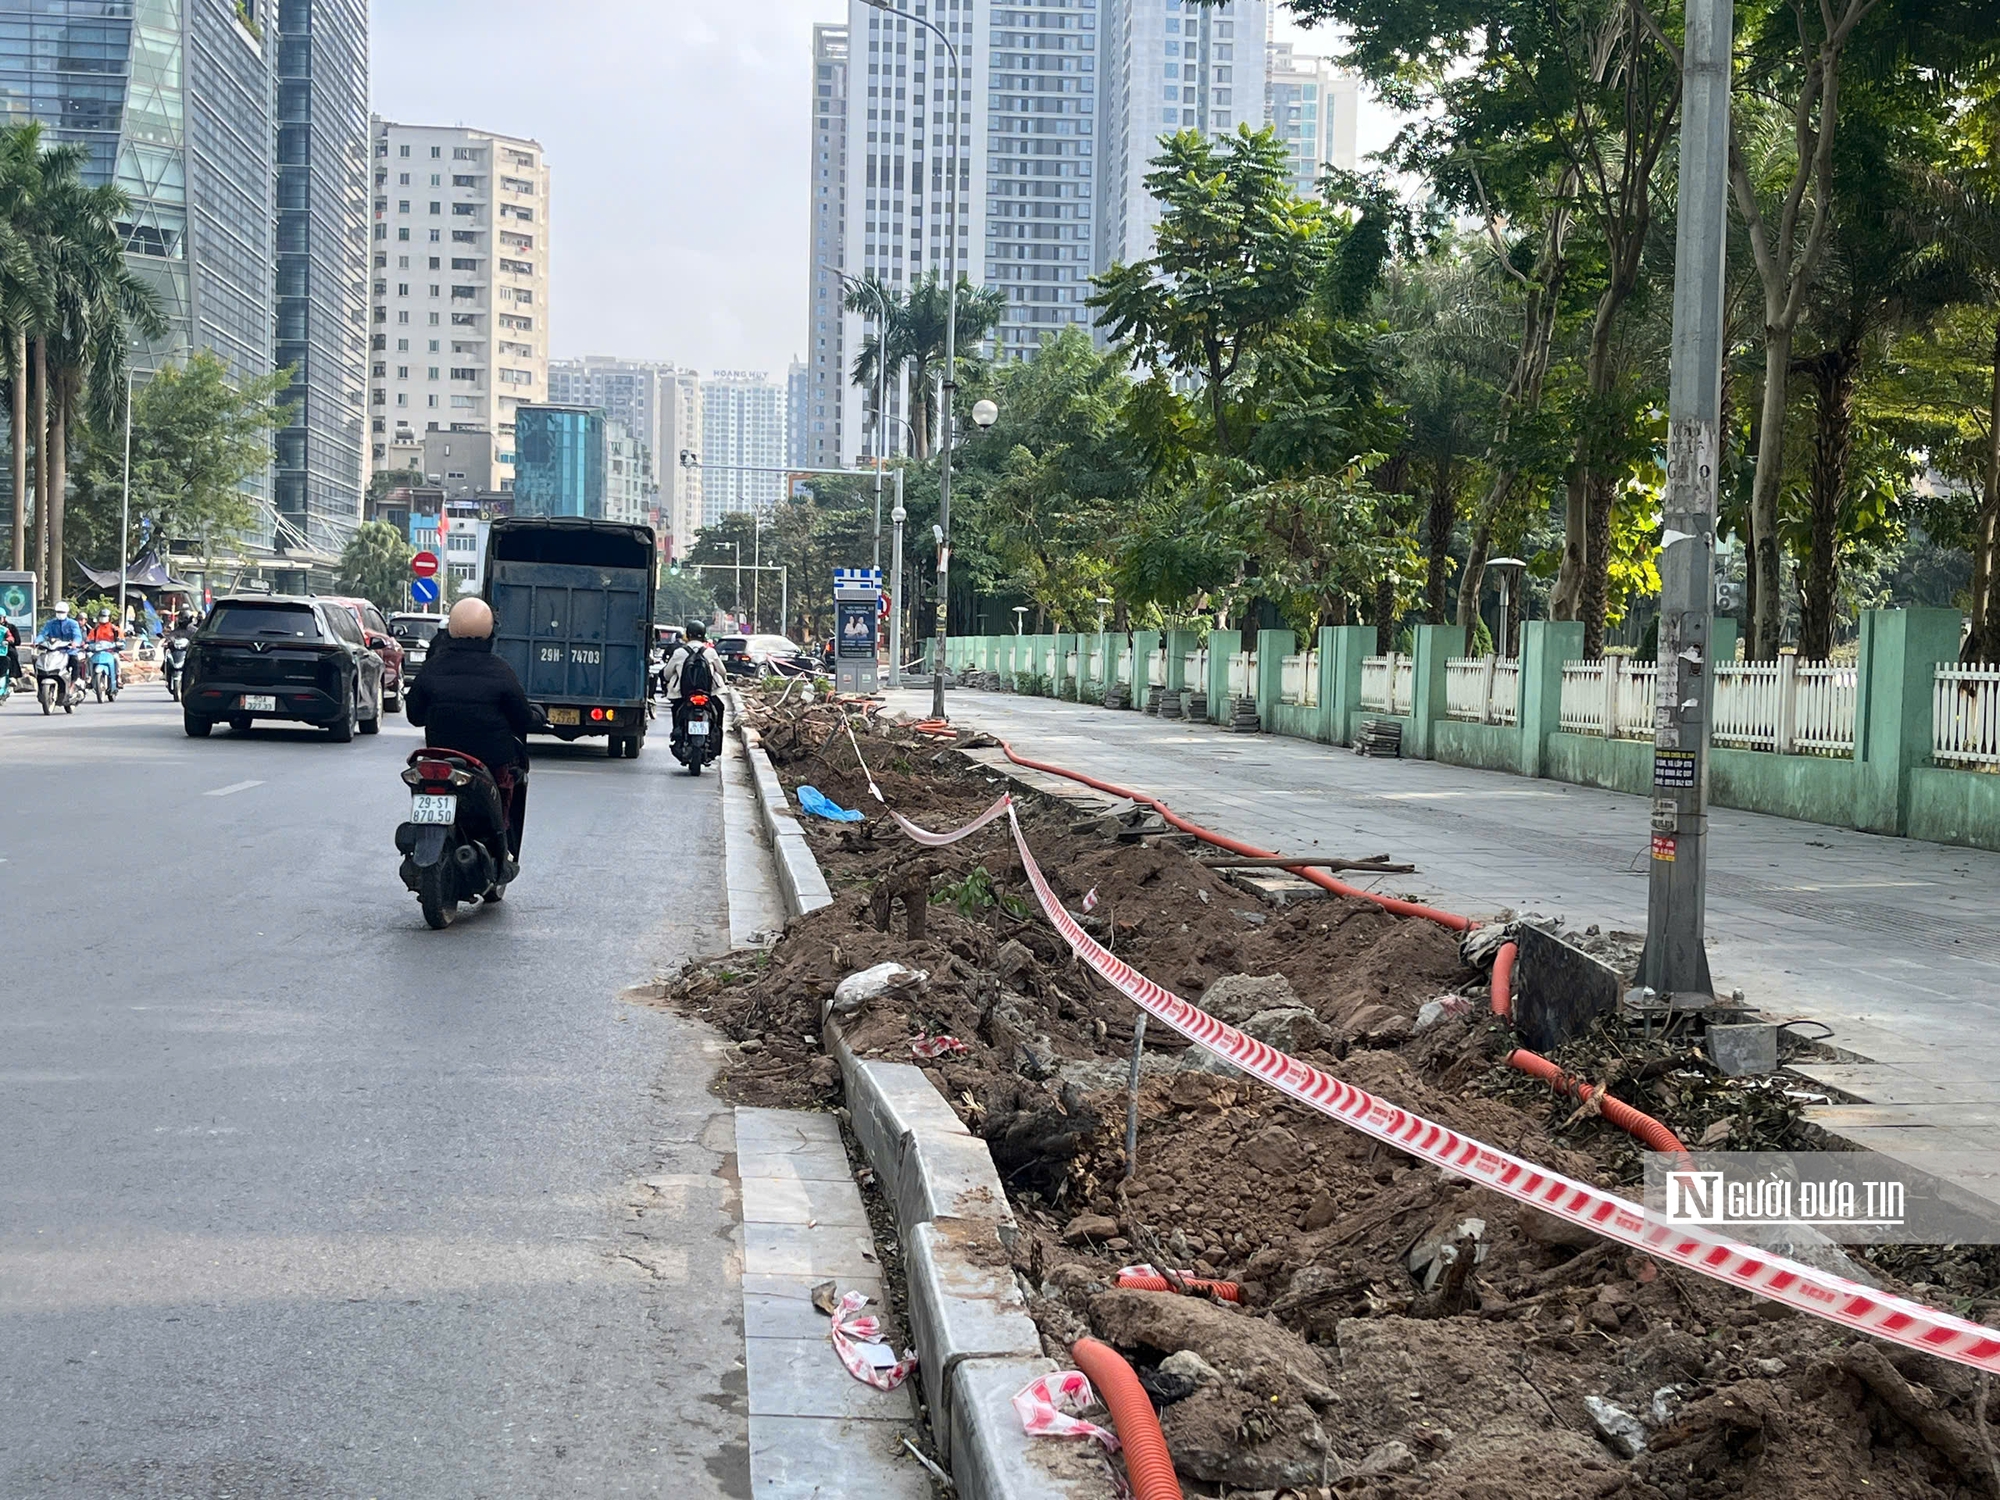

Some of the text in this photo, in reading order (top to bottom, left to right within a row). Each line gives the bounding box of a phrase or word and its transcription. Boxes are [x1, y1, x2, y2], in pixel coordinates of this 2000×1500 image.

[713, 370, 769, 379] HOANG HUY
[571, 649, 600, 664] 74703
[418, 796, 450, 809] 29-S1
[413, 809, 452, 822] 870.50
